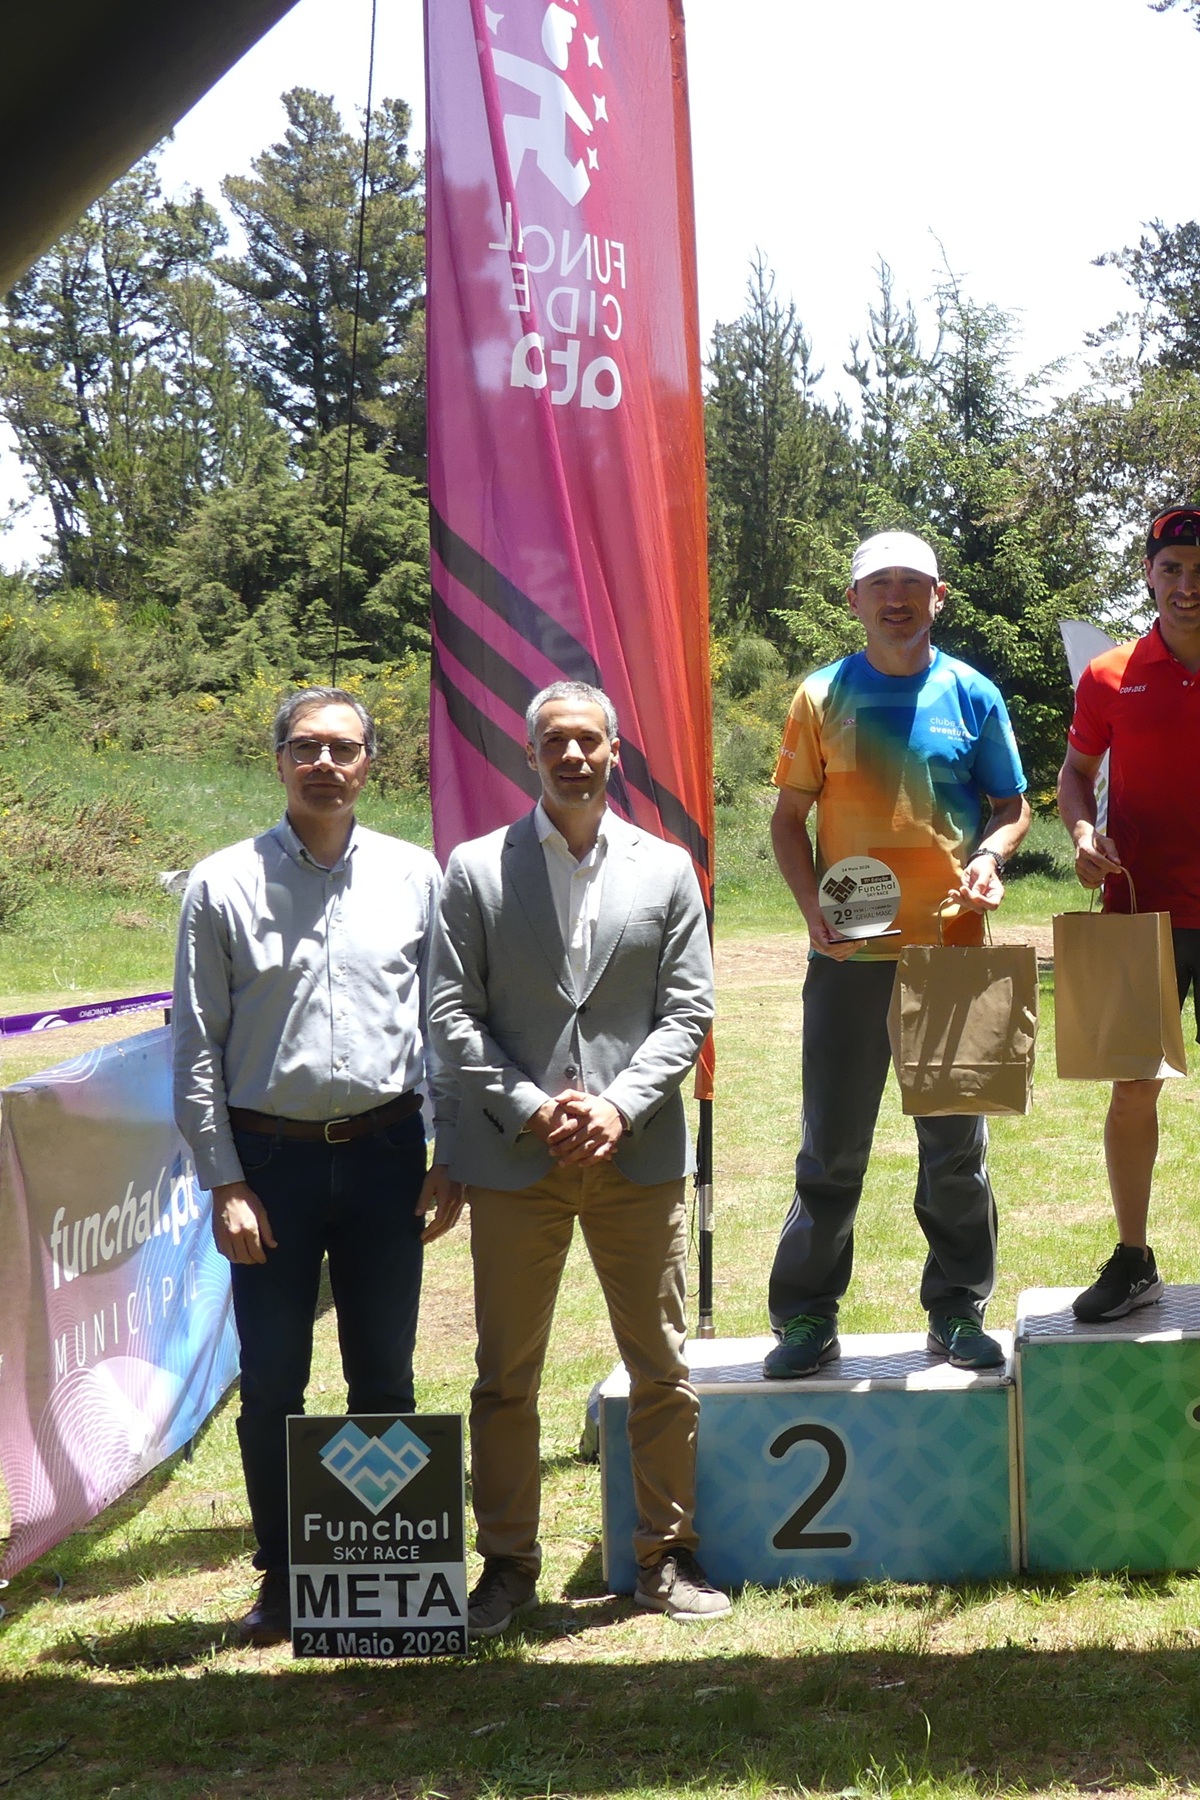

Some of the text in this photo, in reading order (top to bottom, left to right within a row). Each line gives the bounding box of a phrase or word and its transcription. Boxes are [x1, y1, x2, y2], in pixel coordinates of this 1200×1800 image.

[929, 716, 956, 727] clube
[858, 882, 896, 893] Funchal
[51, 1159, 199, 1290] funchal.pt
[54, 1260, 198, 1384] MUNICÍPIO
[769, 1423, 852, 1550] 2
[303, 1512, 449, 1542] Funchal
[333, 1545, 421, 1561] SKY RACE
[296, 1572, 462, 1619] META
[301, 1630, 461, 1656] 24 Maio 2026
